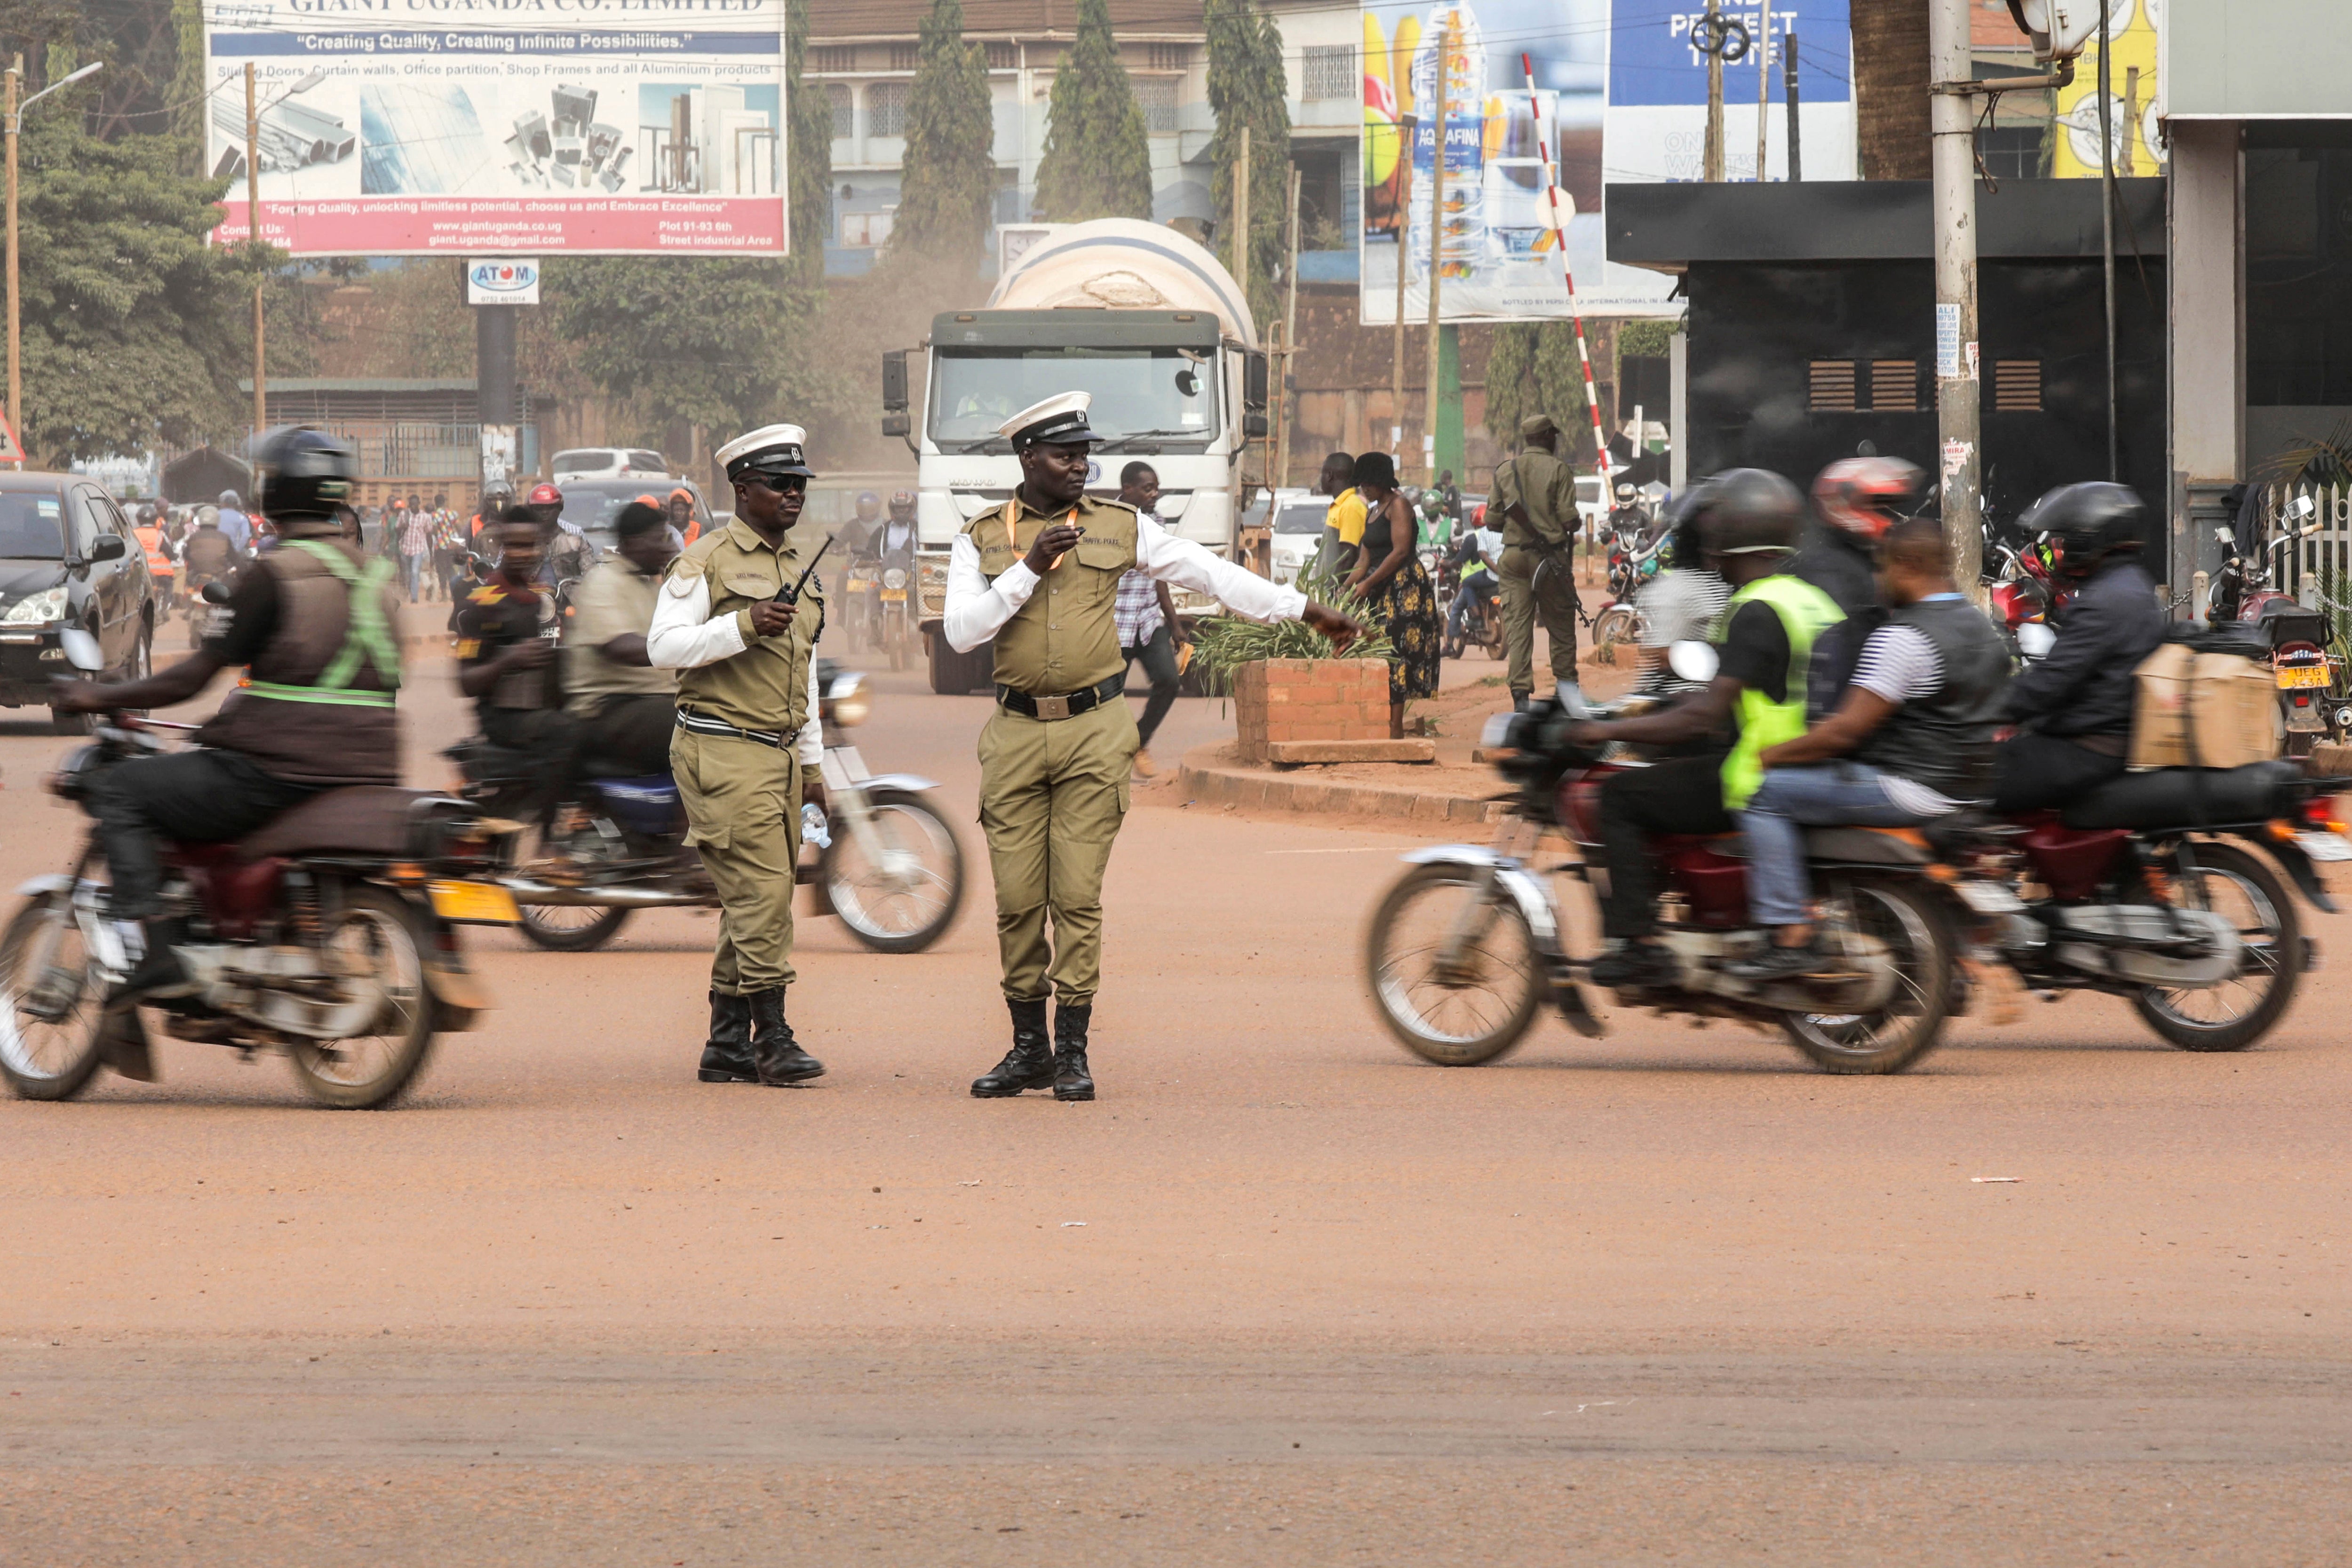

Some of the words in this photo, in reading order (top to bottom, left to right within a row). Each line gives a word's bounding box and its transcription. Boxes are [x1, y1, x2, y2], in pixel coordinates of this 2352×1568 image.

[379, 33, 441, 51] Quality,
[445, 33, 515, 52] Creating
[520, 34, 575, 49] Infinite
[363, 64, 399, 76] walls,
[405, 64, 441, 75] Office
[446, 64, 502, 77] partition,
[507, 64, 540, 77] Shop
[545, 64, 591, 74] Frames
[596, 64, 619, 74] and
[623, 64, 637, 74] all
[642, 63, 710, 74] Aluminium
[715, 64, 771, 76] products
[1418, 127, 1479, 147] AQAFINA
[318, 203, 359, 215] Quality,
[363, 202, 418, 214] unlocking
[421, 201, 467, 211] limitless
[471, 201, 522, 213] potential,
[525, 201, 566, 212] choose
[570, 203, 583, 211] us
[586, 201, 606, 211] and
[610, 201, 658, 212] Embrace
[221, 224, 263, 235] Contat
[266, 223, 284, 234] Us:
[433, 221, 562, 232] www.giantuganda.co.ug
[660, 221, 681, 231] Plot
[683, 222, 712, 231] 91-93
[715, 222, 732, 232] 6th
[429, 235, 565, 247] giant.uganda@gmail.com
[660, 235, 691, 245] Street
[747, 236, 772, 245] Area
[2295, 667, 2320, 677] UEG
